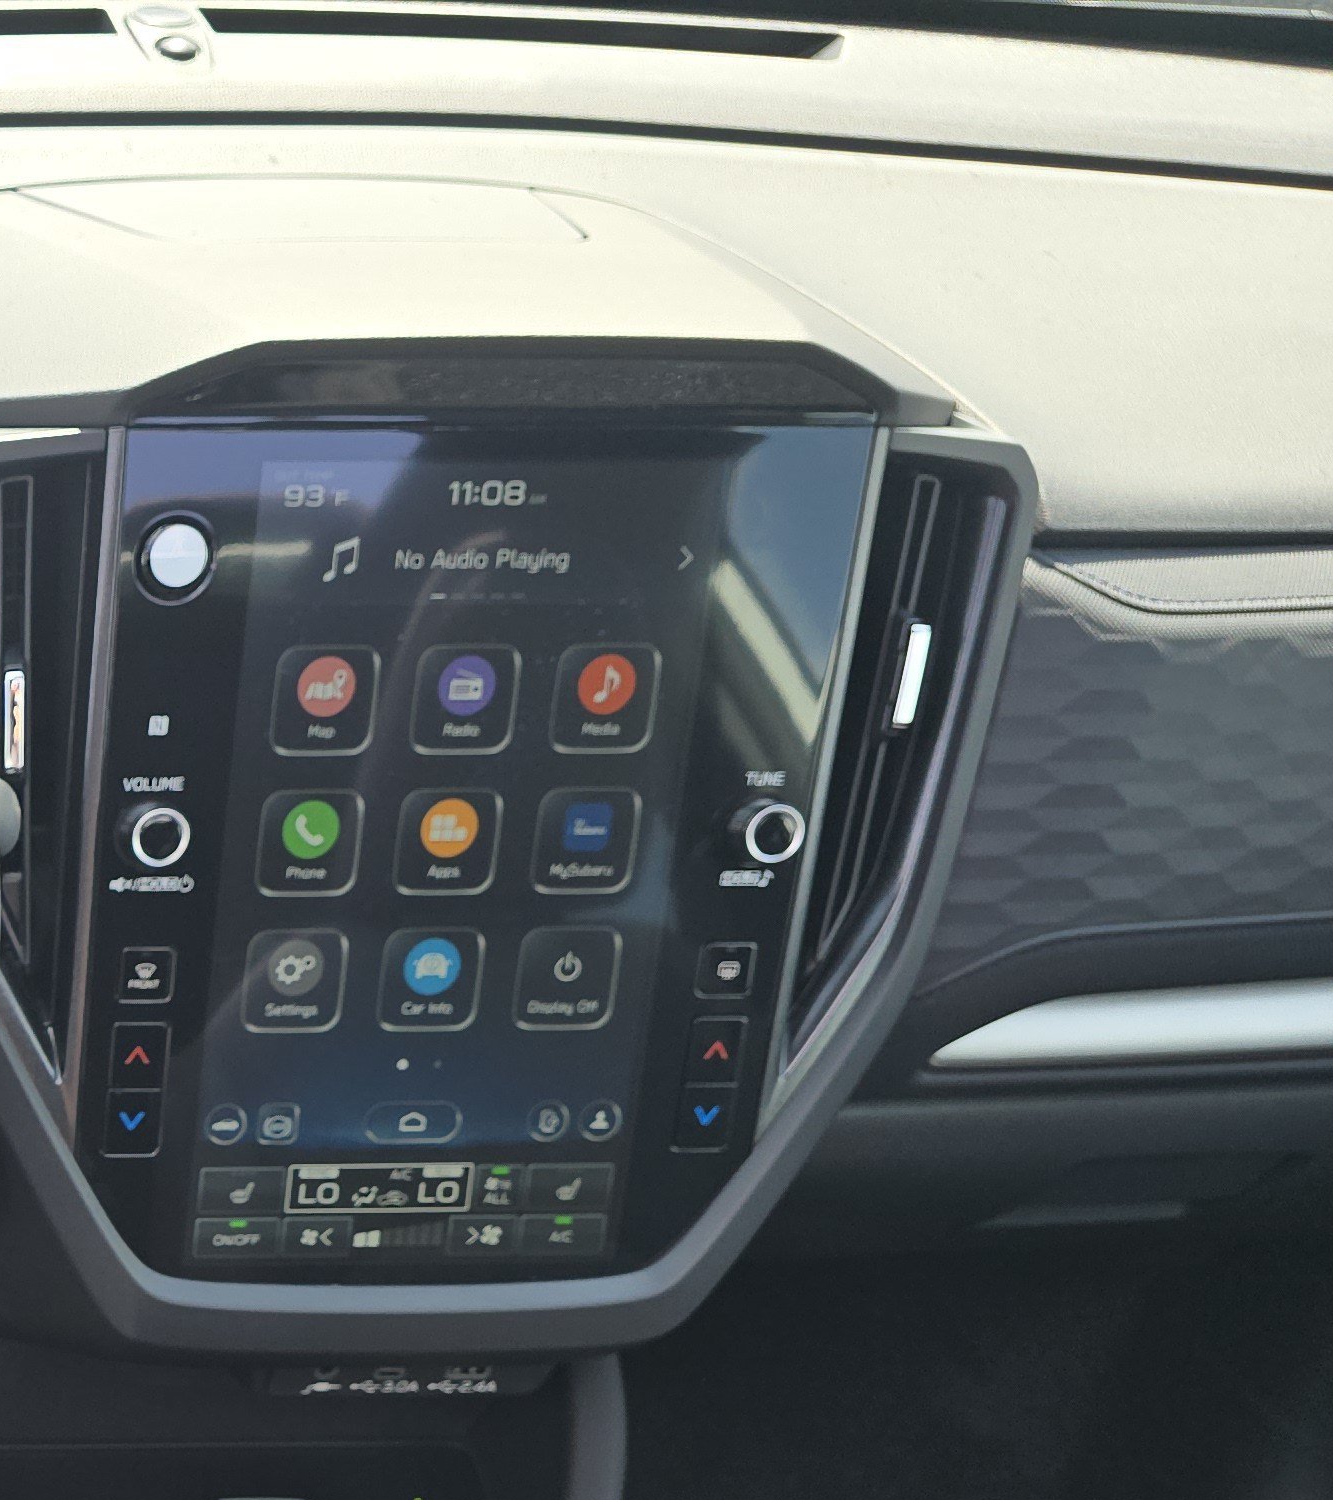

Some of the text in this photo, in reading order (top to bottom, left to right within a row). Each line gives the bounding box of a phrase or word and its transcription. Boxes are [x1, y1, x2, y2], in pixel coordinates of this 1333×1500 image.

[284, 484, 326, 507] 93
[448, 480, 527, 506] 11:08
[395, 548, 571, 574] No Audio Playing
[442, 722, 481, 738] Radio
[581, 722, 621, 736] Media
[123, 776, 185, 792] VOLUME
[745, 770, 786, 786] TUNE
[285, 866, 327, 880] Phone
[549, 863, 614, 880] MySubaru
[264, 1002, 319, 1019] Settings
[401, 1002, 454, 1016] Car Info
[527, 1000, 599, 1016] Display Off
[298, 1182, 340, 1205] LO
[417, 1181, 461, 1204] LO
